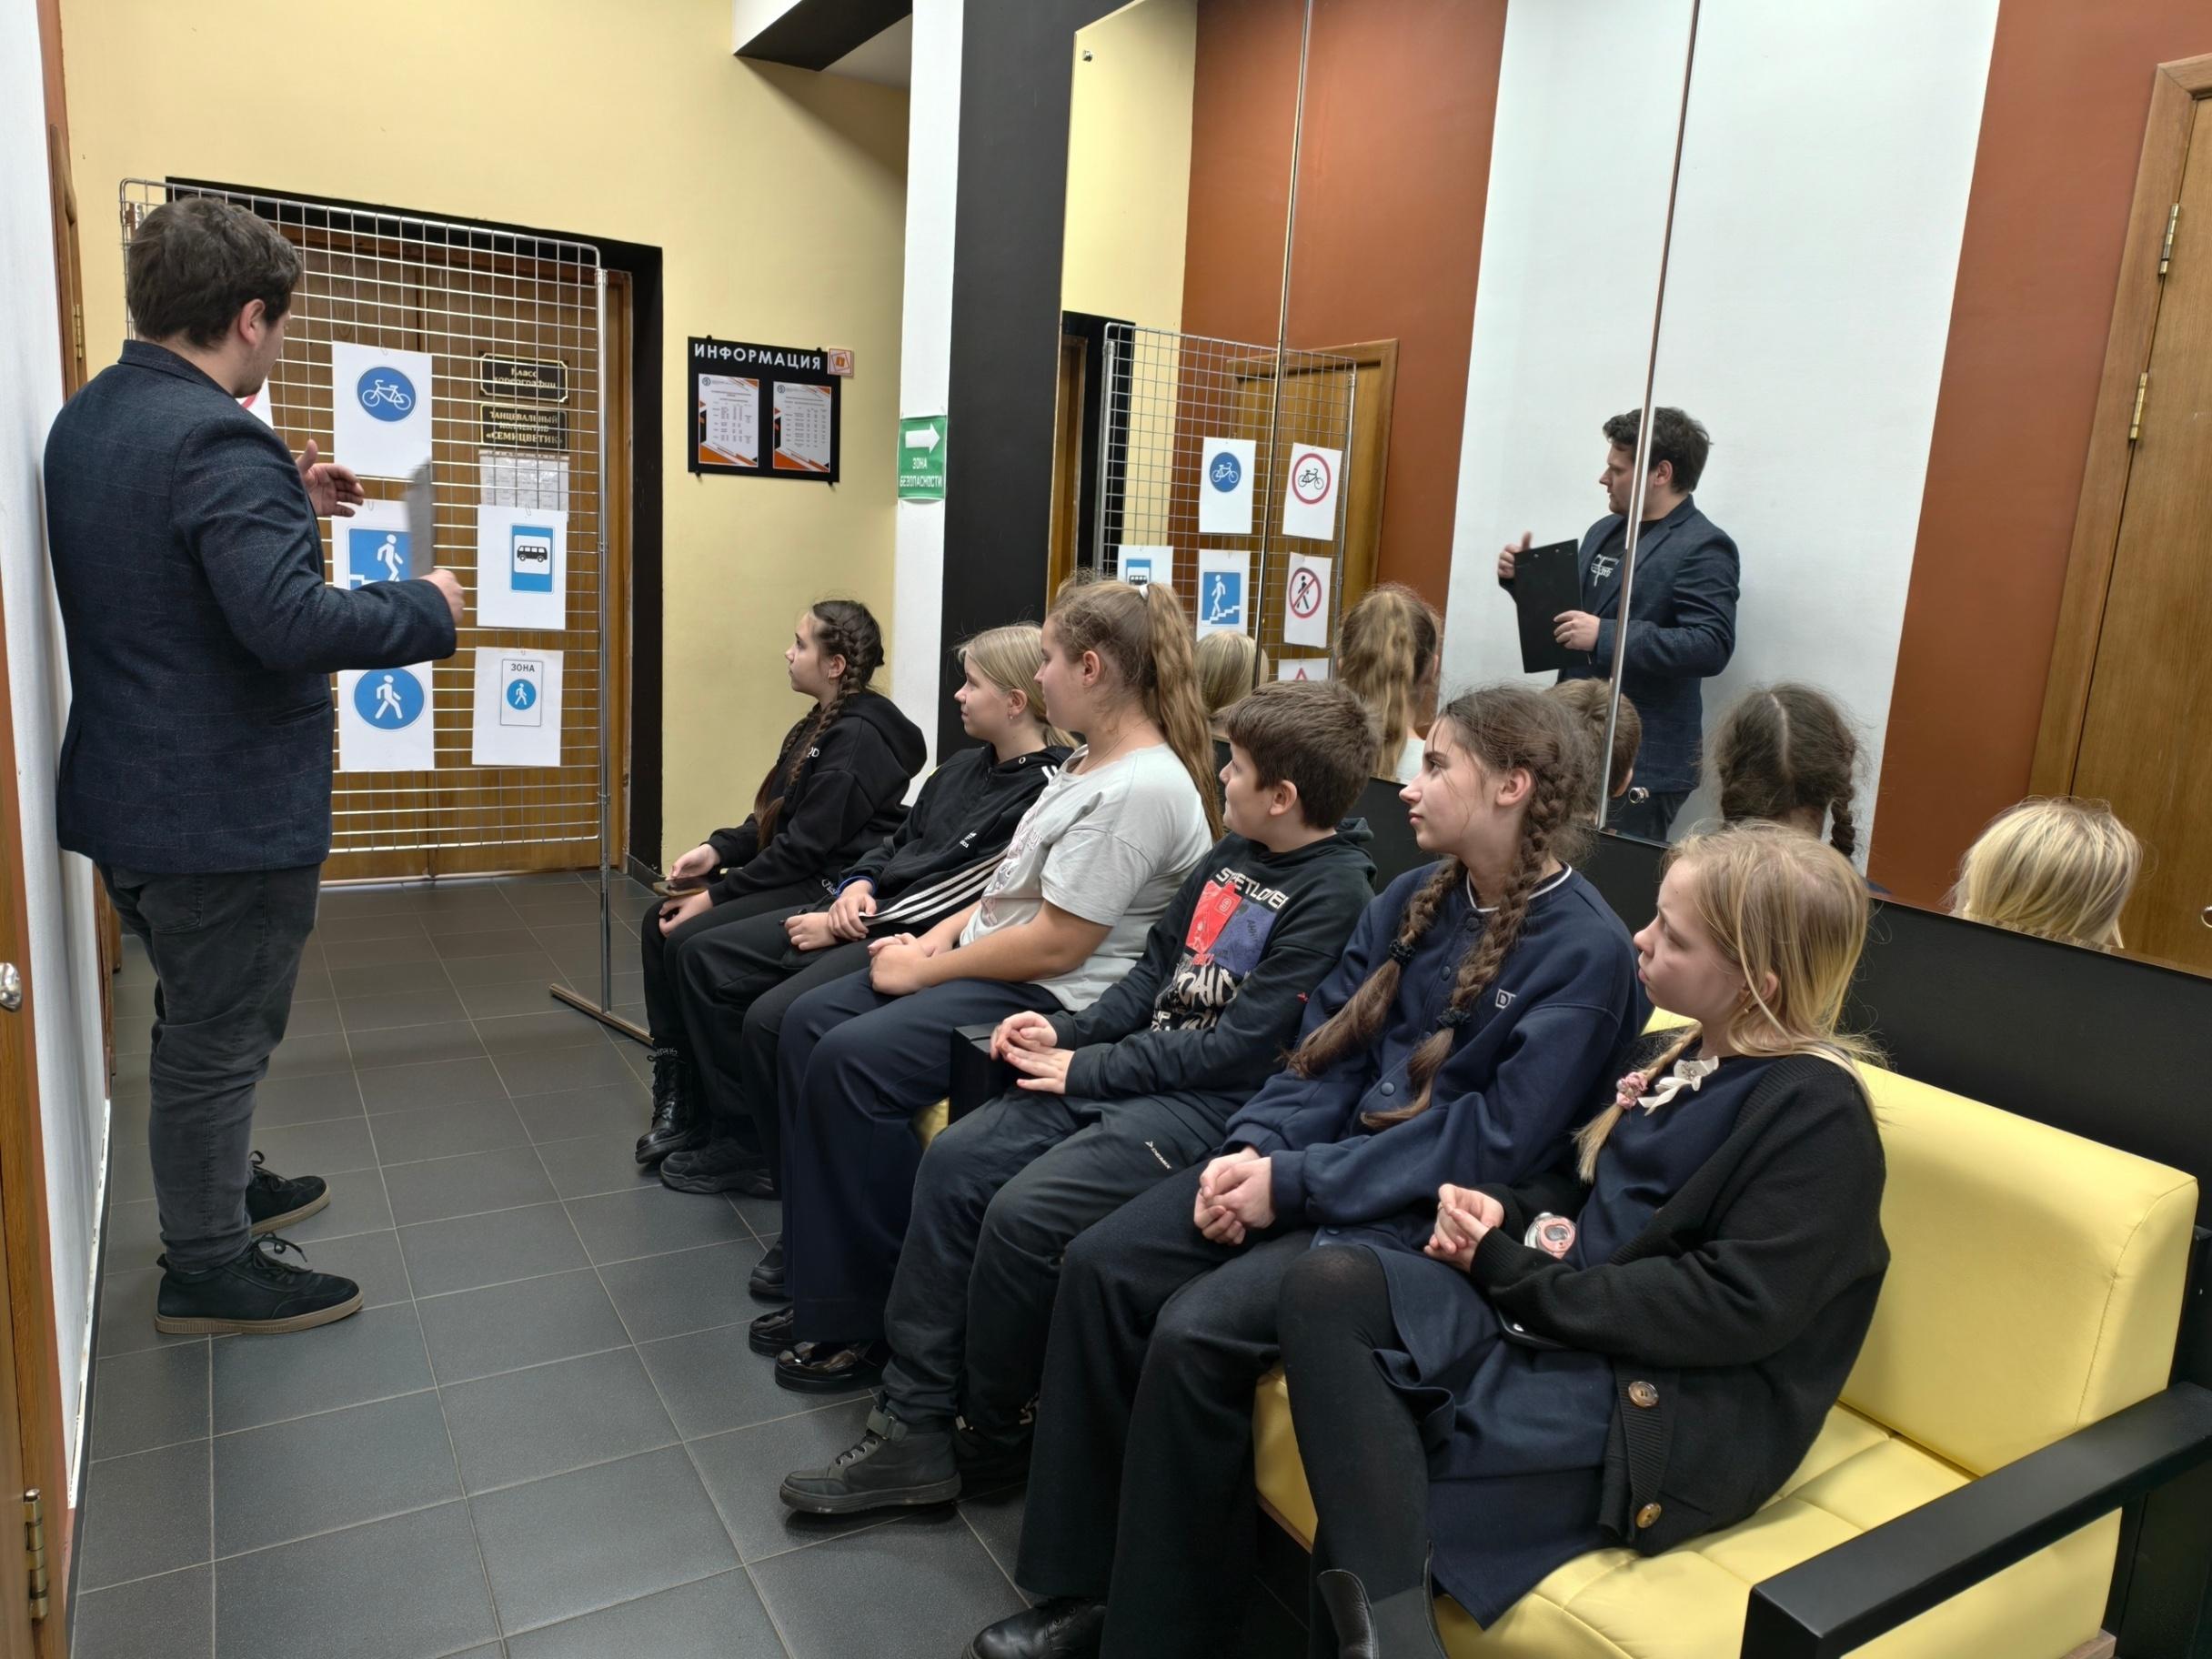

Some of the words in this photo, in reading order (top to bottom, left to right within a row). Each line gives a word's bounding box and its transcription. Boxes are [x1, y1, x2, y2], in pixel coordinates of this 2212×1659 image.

[694, 343, 821, 370] ИНФОРМАЦИЯ
[912, 457, 928, 469] ЗОНА
[900, 475, 942, 488] БЕЗОПАСНОСТИ
[511, 663, 535, 672] ЗОНА
